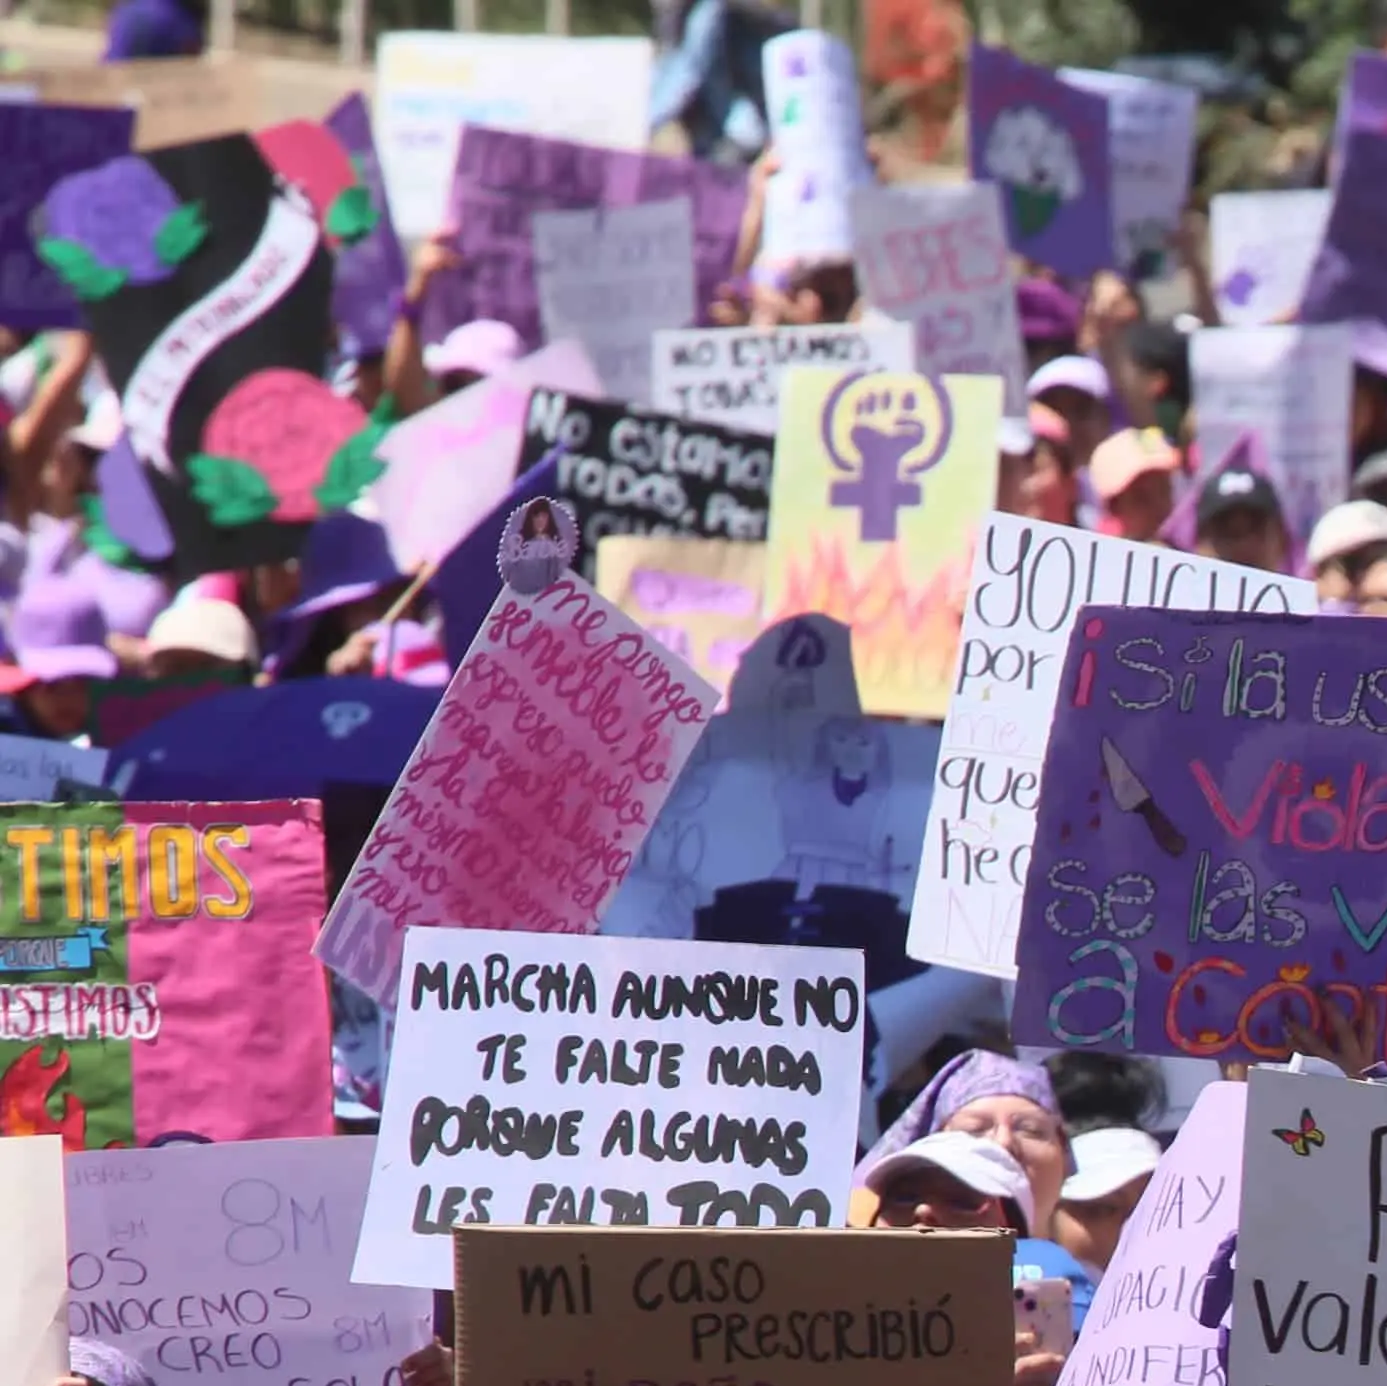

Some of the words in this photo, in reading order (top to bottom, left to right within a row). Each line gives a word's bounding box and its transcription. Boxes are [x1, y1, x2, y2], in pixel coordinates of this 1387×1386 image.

[975, 525, 1076, 634] YO
[958, 636, 1055, 698] por
[1222, 636, 1290, 722] la
[939, 755, 1041, 822] que
[1044, 858, 1156, 941] se
[1188, 849, 1310, 950] las
[410, 951, 597, 1014] MARCHA
[611, 967, 785, 1028] AUNQUE
[793, 975, 859, 1033] NO
[1047, 938, 1140, 1052] a
[477, 1033, 527, 1086] TE
[554, 1035, 681, 1089] FALTE
[706, 1043, 822, 1096] NADA
[408, 1094, 584, 1167] PORQUE
[600, 1108, 809, 1176] ALGUNAS
[221, 1176, 334, 1268] 8M
[1147, 1175, 1226, 1240] HAY
[517, 1253, 594, 1317] mi
[631, 1254, 766, 1306] caso
[156, 1332, 283, 1374] CREO
